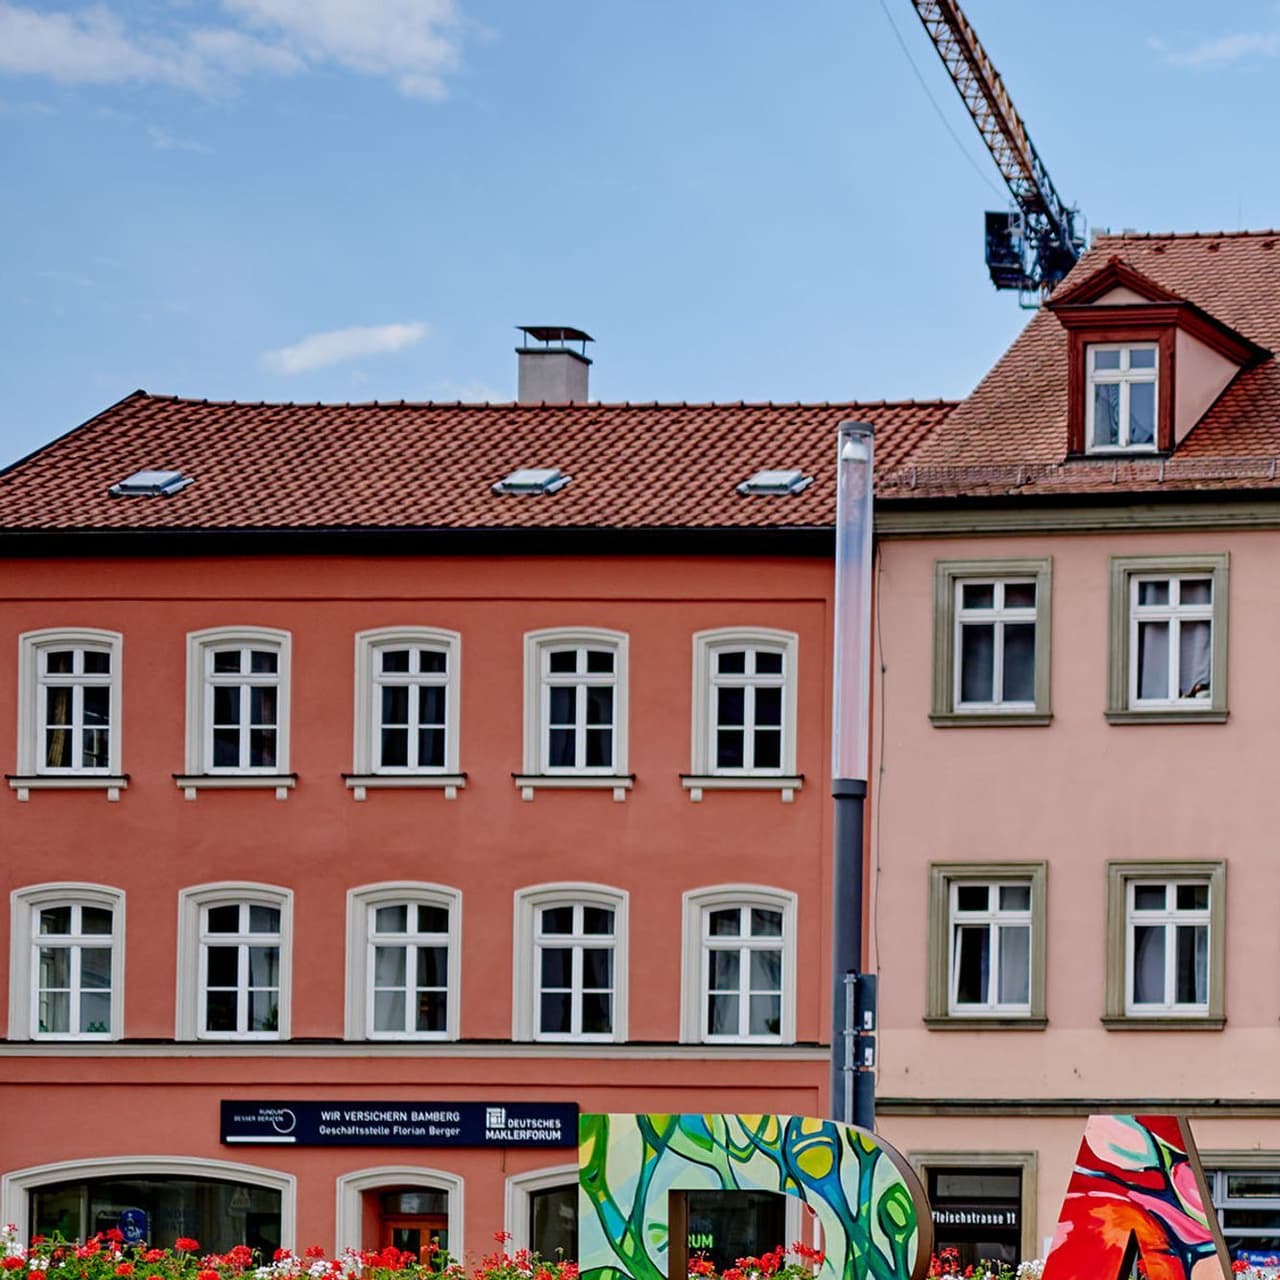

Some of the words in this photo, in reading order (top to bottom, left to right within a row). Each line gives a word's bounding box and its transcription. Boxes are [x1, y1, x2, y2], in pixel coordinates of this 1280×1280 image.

[321, 1111, 341, 1121] WIR
[344, 1111, 407, 1121] VERSICHERN
[411, 1111, 460, 1122] BAMBERG
[507, 1119, 561, 1128] DEUTSCHES
[319, 1125, 390, 1136] Geschäftsstelle
[393, 1125, 426, 1136] Florian
[429, 1125, 461, 1138] Berger
[485, 1130, 561, 1140] MAKLERFORUM
[931, 1211, 1004, 1224] Fleischstrasse
[1006, 1211, 1016, 1224] 11
